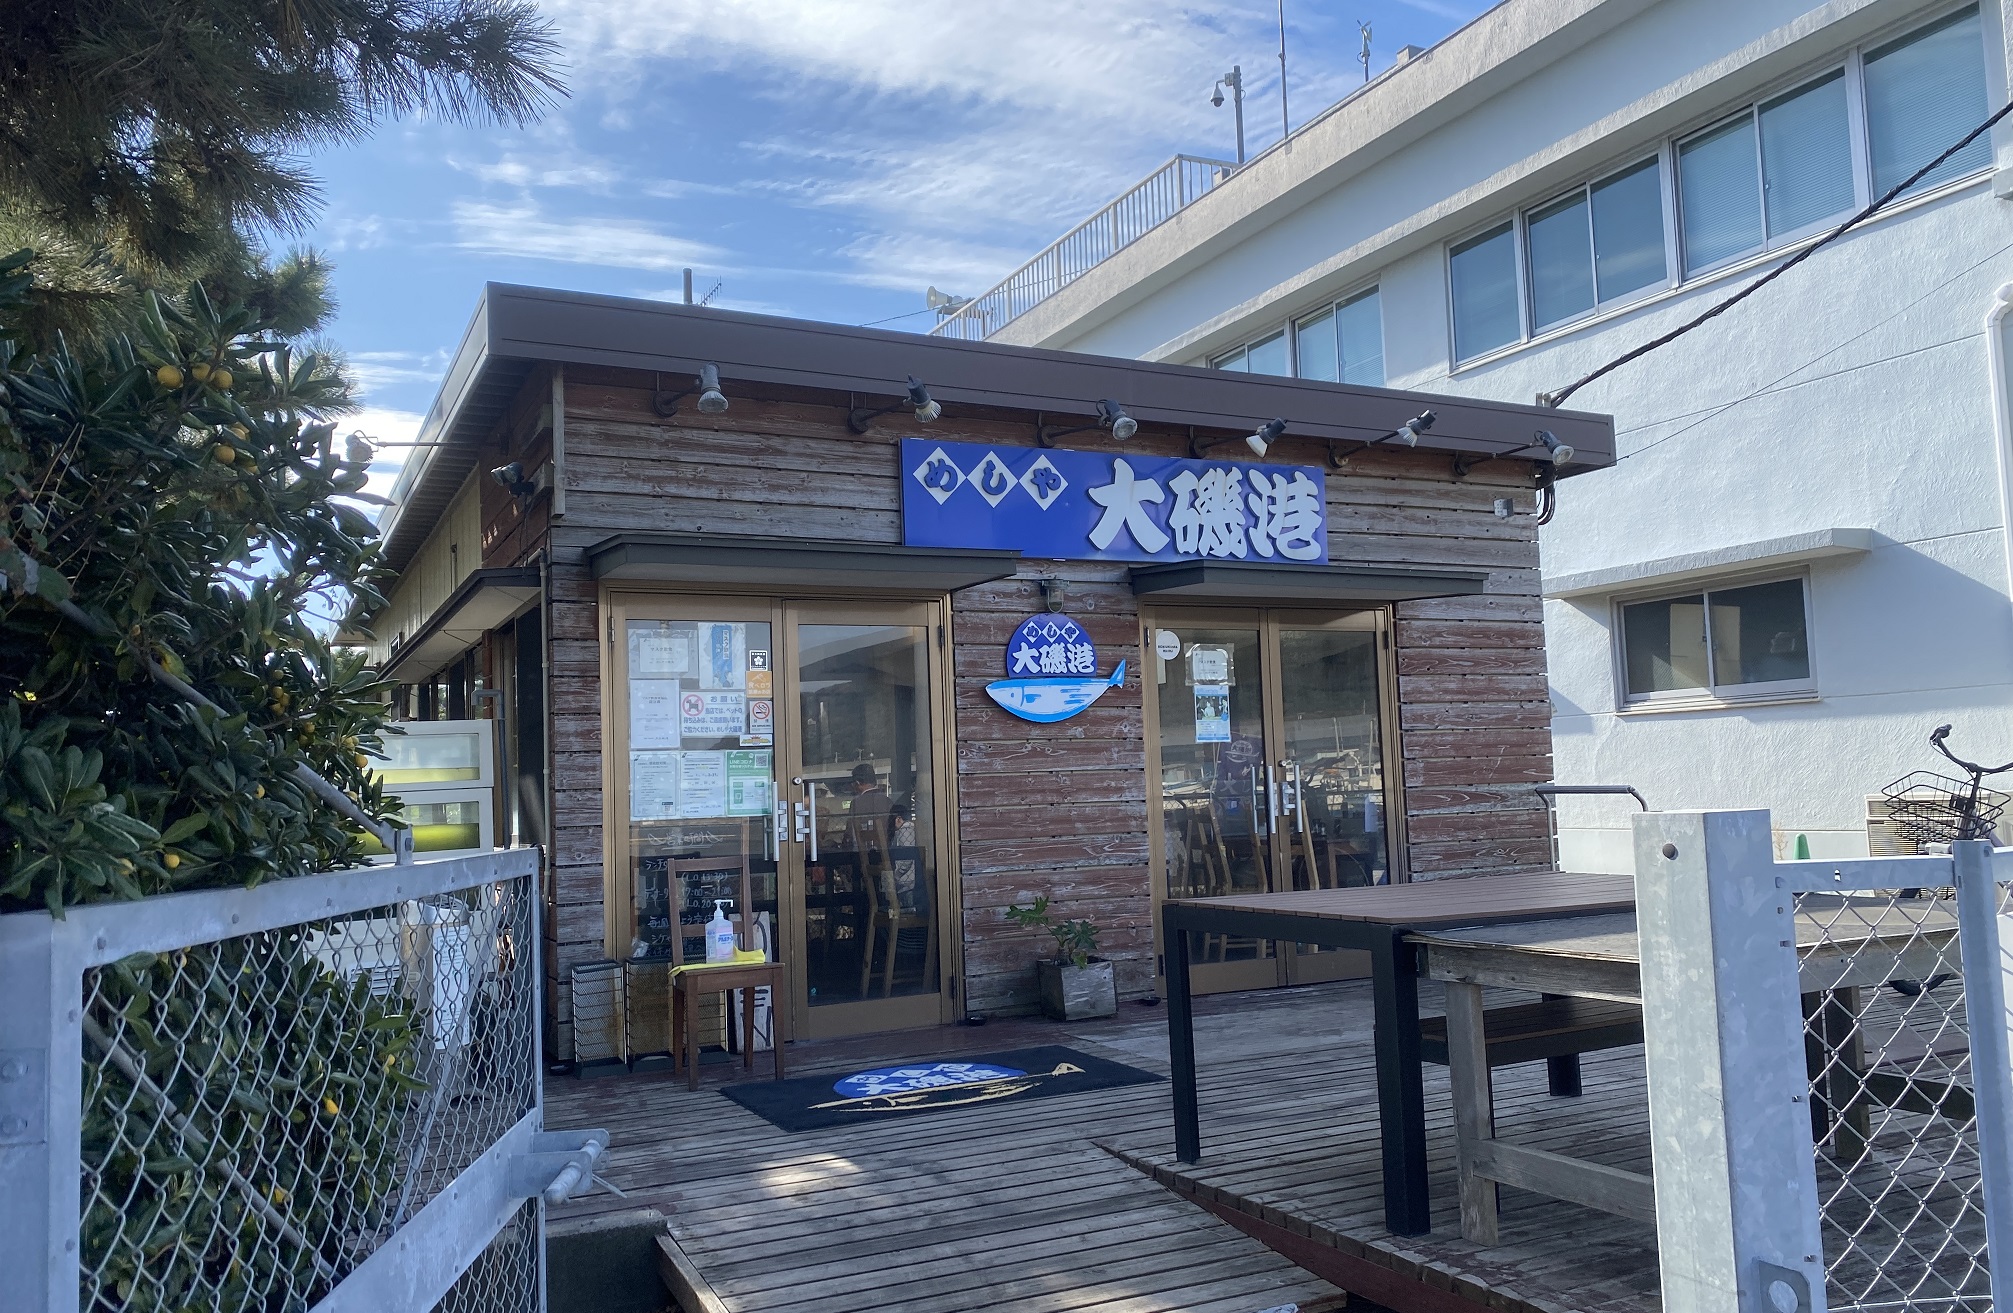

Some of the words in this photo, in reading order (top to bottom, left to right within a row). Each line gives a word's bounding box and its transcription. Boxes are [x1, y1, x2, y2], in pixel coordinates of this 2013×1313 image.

[923, 456, 1063, 501] めしや
[1087, 456, 1324, 561] 大磯港
[1026, 624, 1077, 640] めしや
[1012, 641, 1095, 674] 大磯港
